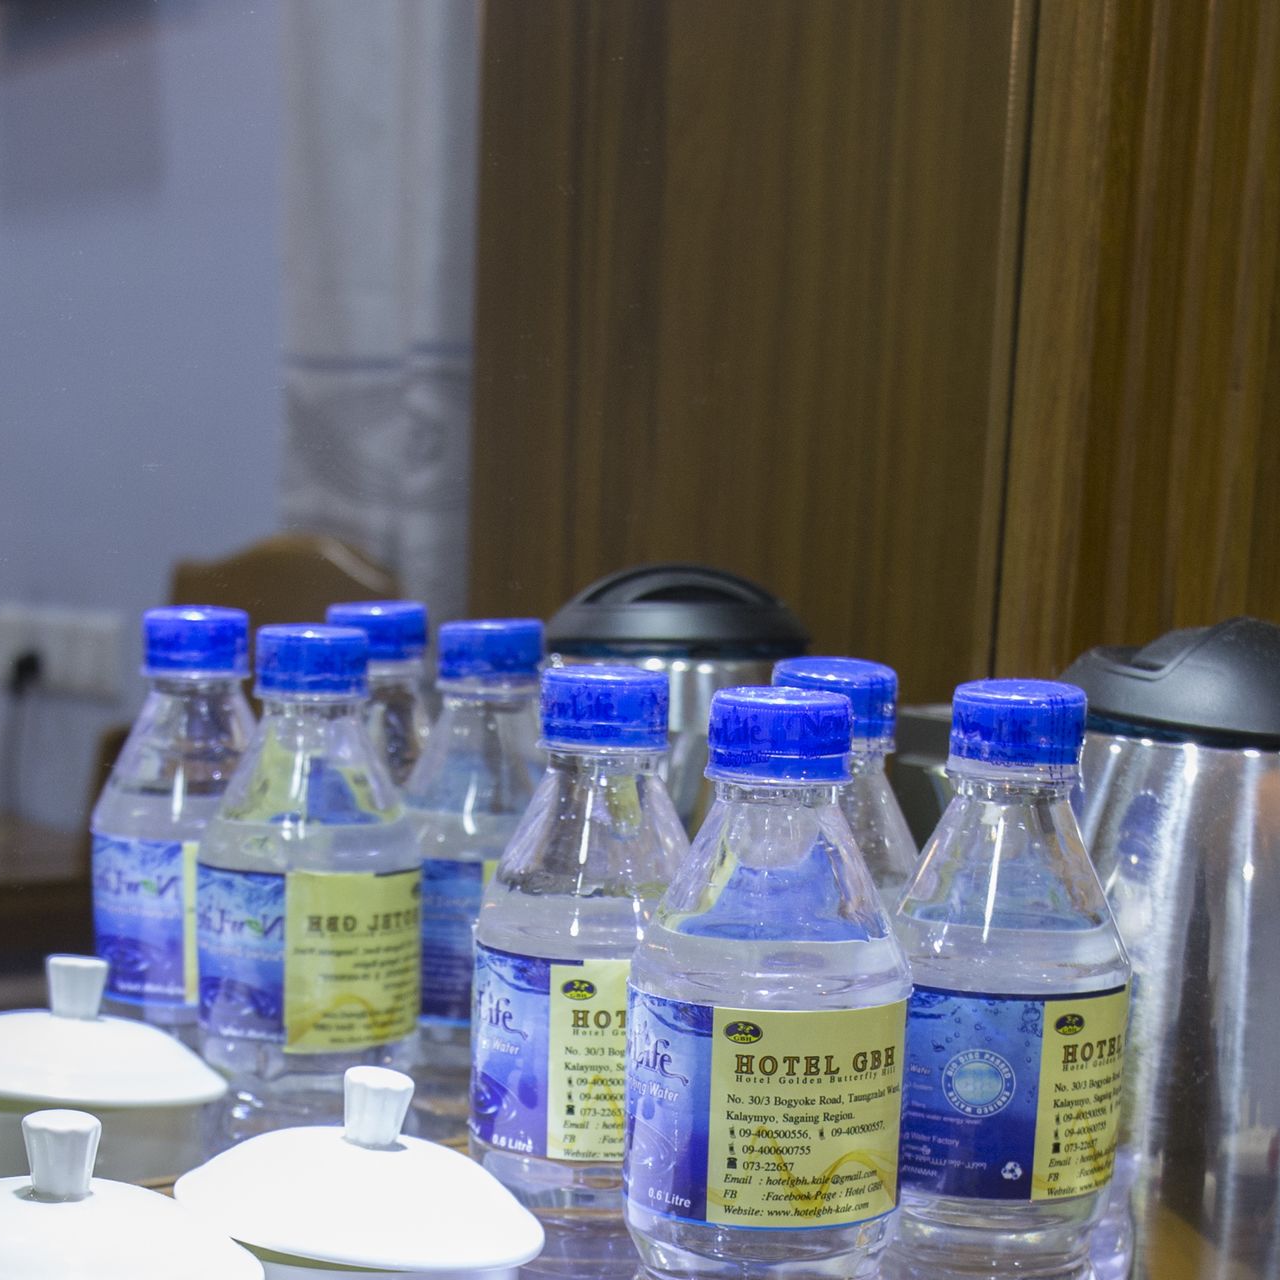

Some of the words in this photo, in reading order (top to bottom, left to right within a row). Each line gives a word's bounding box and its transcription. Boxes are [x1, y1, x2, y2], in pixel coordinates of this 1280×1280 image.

[734, 1054, 840, 1076] HOTEL
[852, 1045, 895, 1073] GBH
[735, 1074, 771, 1084] Hotel
[778, 1076, 822, 1085] Golden
[829, 1071, 877, 1084] Butterfly
[649, 1081, 679, 1103] Water
[726, 1093, 745, 1104] No.
[748, 1095, 771, 1106] 30/3
[773, 1096, 816, 1109] Bogyoke
[782, 1113, 820, 1126] Sagaing
[742, 1144, 812, 1155] 09-400600755
[742, 1161, 795, 1172] 073-22657
[1048, 1156, 1072, 1168] Email
[723, 1173, 753, 1185] Email
[1047, 1172, 1060, 1182] FB
[648, 1189, 663, 1201] 0.6
[664, 1191, 692, 1208] Litre
[723, 1189, 738, 1199] FB
[814, 1190, 837, 1202] Page
[844, 1185, 866, 1198] Hotel
[723, 1205, 764, 1217] Website:
